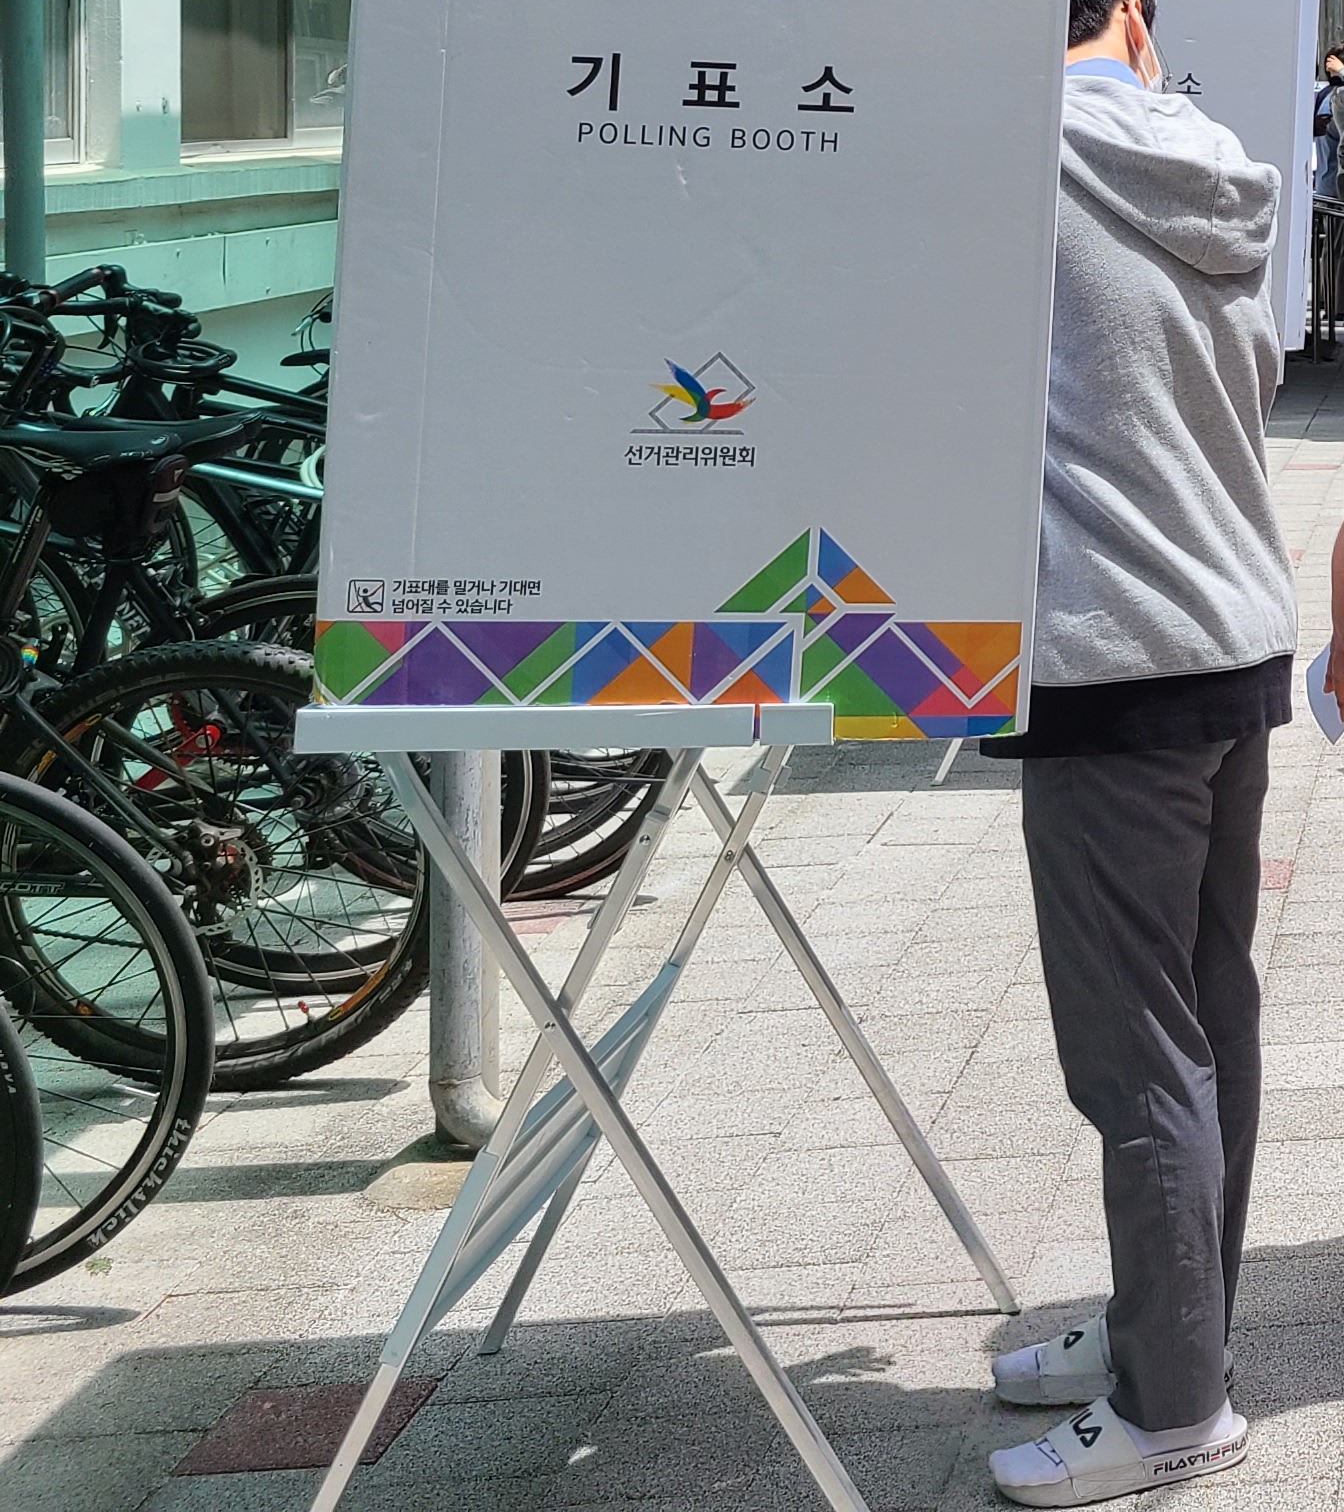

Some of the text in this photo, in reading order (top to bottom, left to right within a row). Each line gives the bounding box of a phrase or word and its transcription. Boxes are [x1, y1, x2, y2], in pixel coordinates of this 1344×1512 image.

[1176, 72, 1203, 96] 소
[577, 122, 839, 153] POLLING BOOTH
[623, 445, 756, 468] 선거관리위원회
[392, 579, 541, 597] 기표대를 밀거나 기대면
[391, 598, 514, 615] 넘어질 수 있습니다
[0, 881, 65, 895] COTT
[1154, 1458, 1187, 1475] FILA
